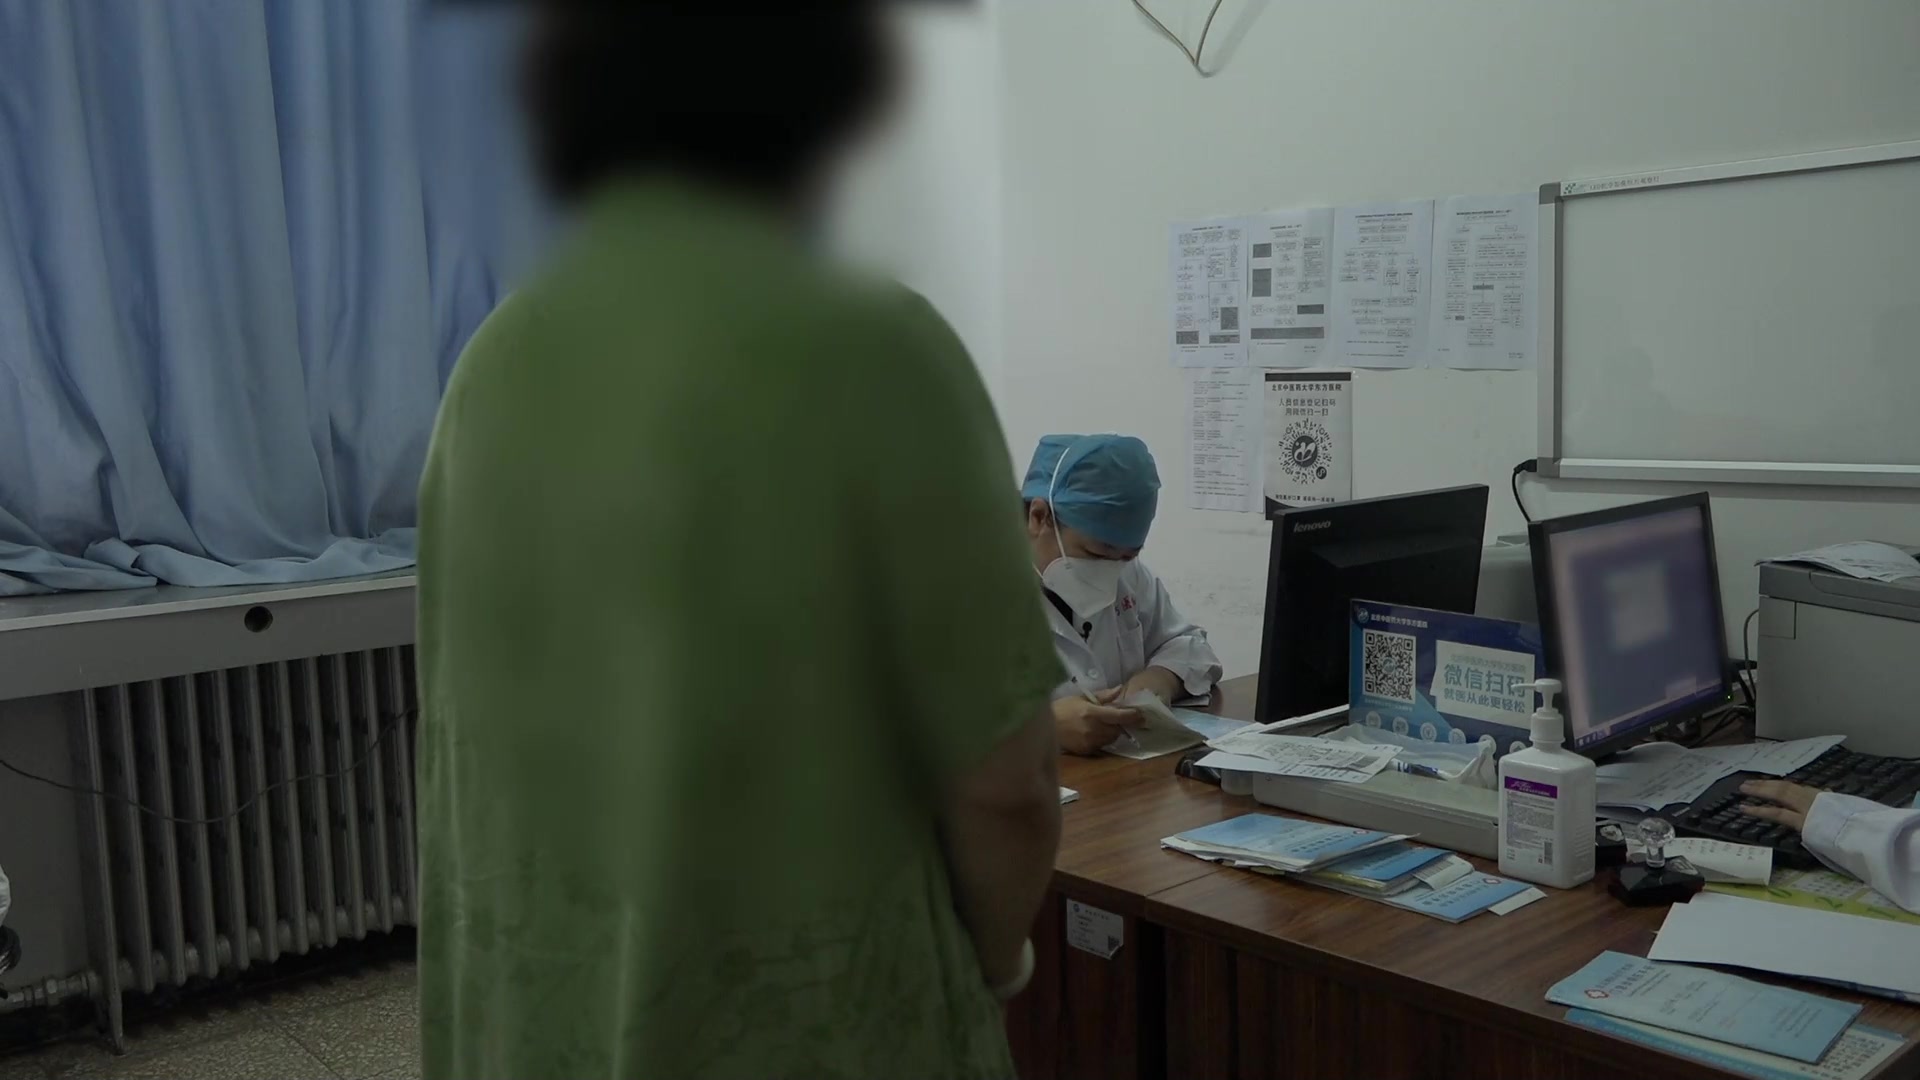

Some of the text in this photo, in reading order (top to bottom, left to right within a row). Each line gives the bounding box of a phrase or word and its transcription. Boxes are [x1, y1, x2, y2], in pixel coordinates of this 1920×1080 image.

[1293, 520, 1331, 533] lenovo
[1443, 664, 1526, 698] 微信扫码
[1443, 690, 1526, 714] 就医从此更轻松
